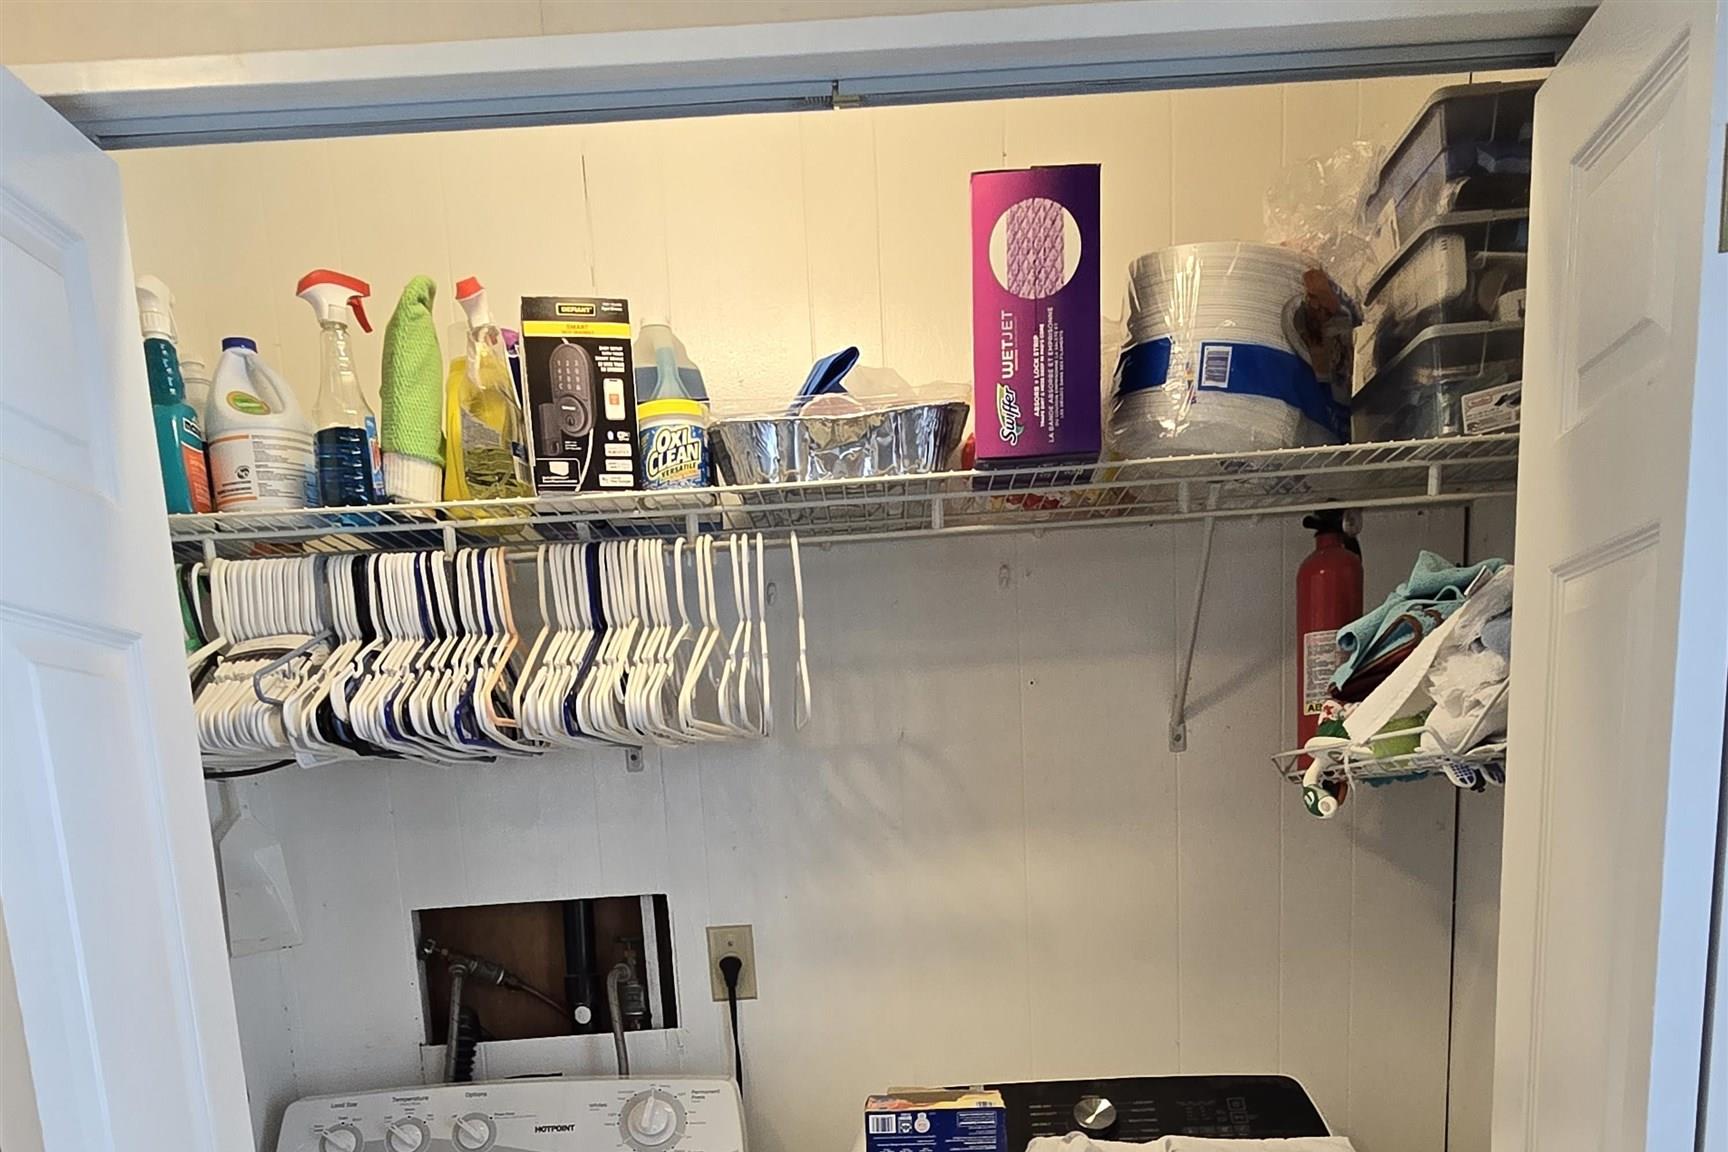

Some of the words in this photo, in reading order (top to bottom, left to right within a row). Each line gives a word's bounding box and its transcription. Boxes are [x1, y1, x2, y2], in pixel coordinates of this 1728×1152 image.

[560, 306, 593, 314] DEFIANT
[1002, 310, 1013, 379] WETJET
[1000, 385, 1021, 446] Swiffer
[656, 428, 688, 453] OXI
[1048, 432, 1055, 443] LA
[648, 442, 699, 478] CLEAN
[662, 462, 696, 478] VERSATILE
[535, 1124, 576, 1133] HOTPOINT
